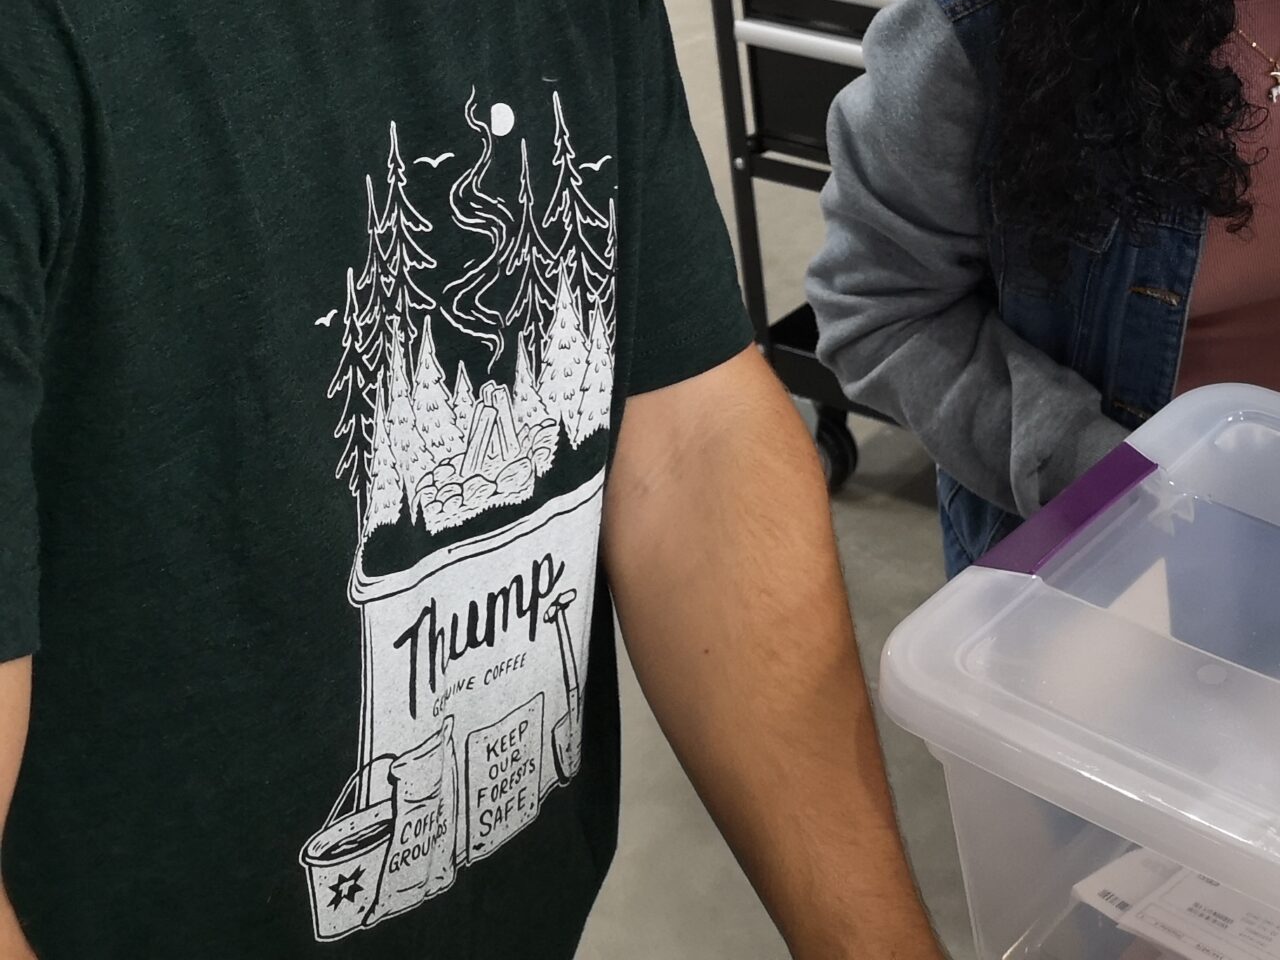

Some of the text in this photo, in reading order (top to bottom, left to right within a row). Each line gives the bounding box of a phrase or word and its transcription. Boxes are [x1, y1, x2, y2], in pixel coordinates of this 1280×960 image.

[393, 552, 566, 720] Thump
[484, 652, 527, 686] COFFEE
[486, 720, 529, 762] KEEP
[477, 758, 536, 808] FORESTS
[488, 749, 522, 780] OUR
[479, 787, 528, 837] SAFE
